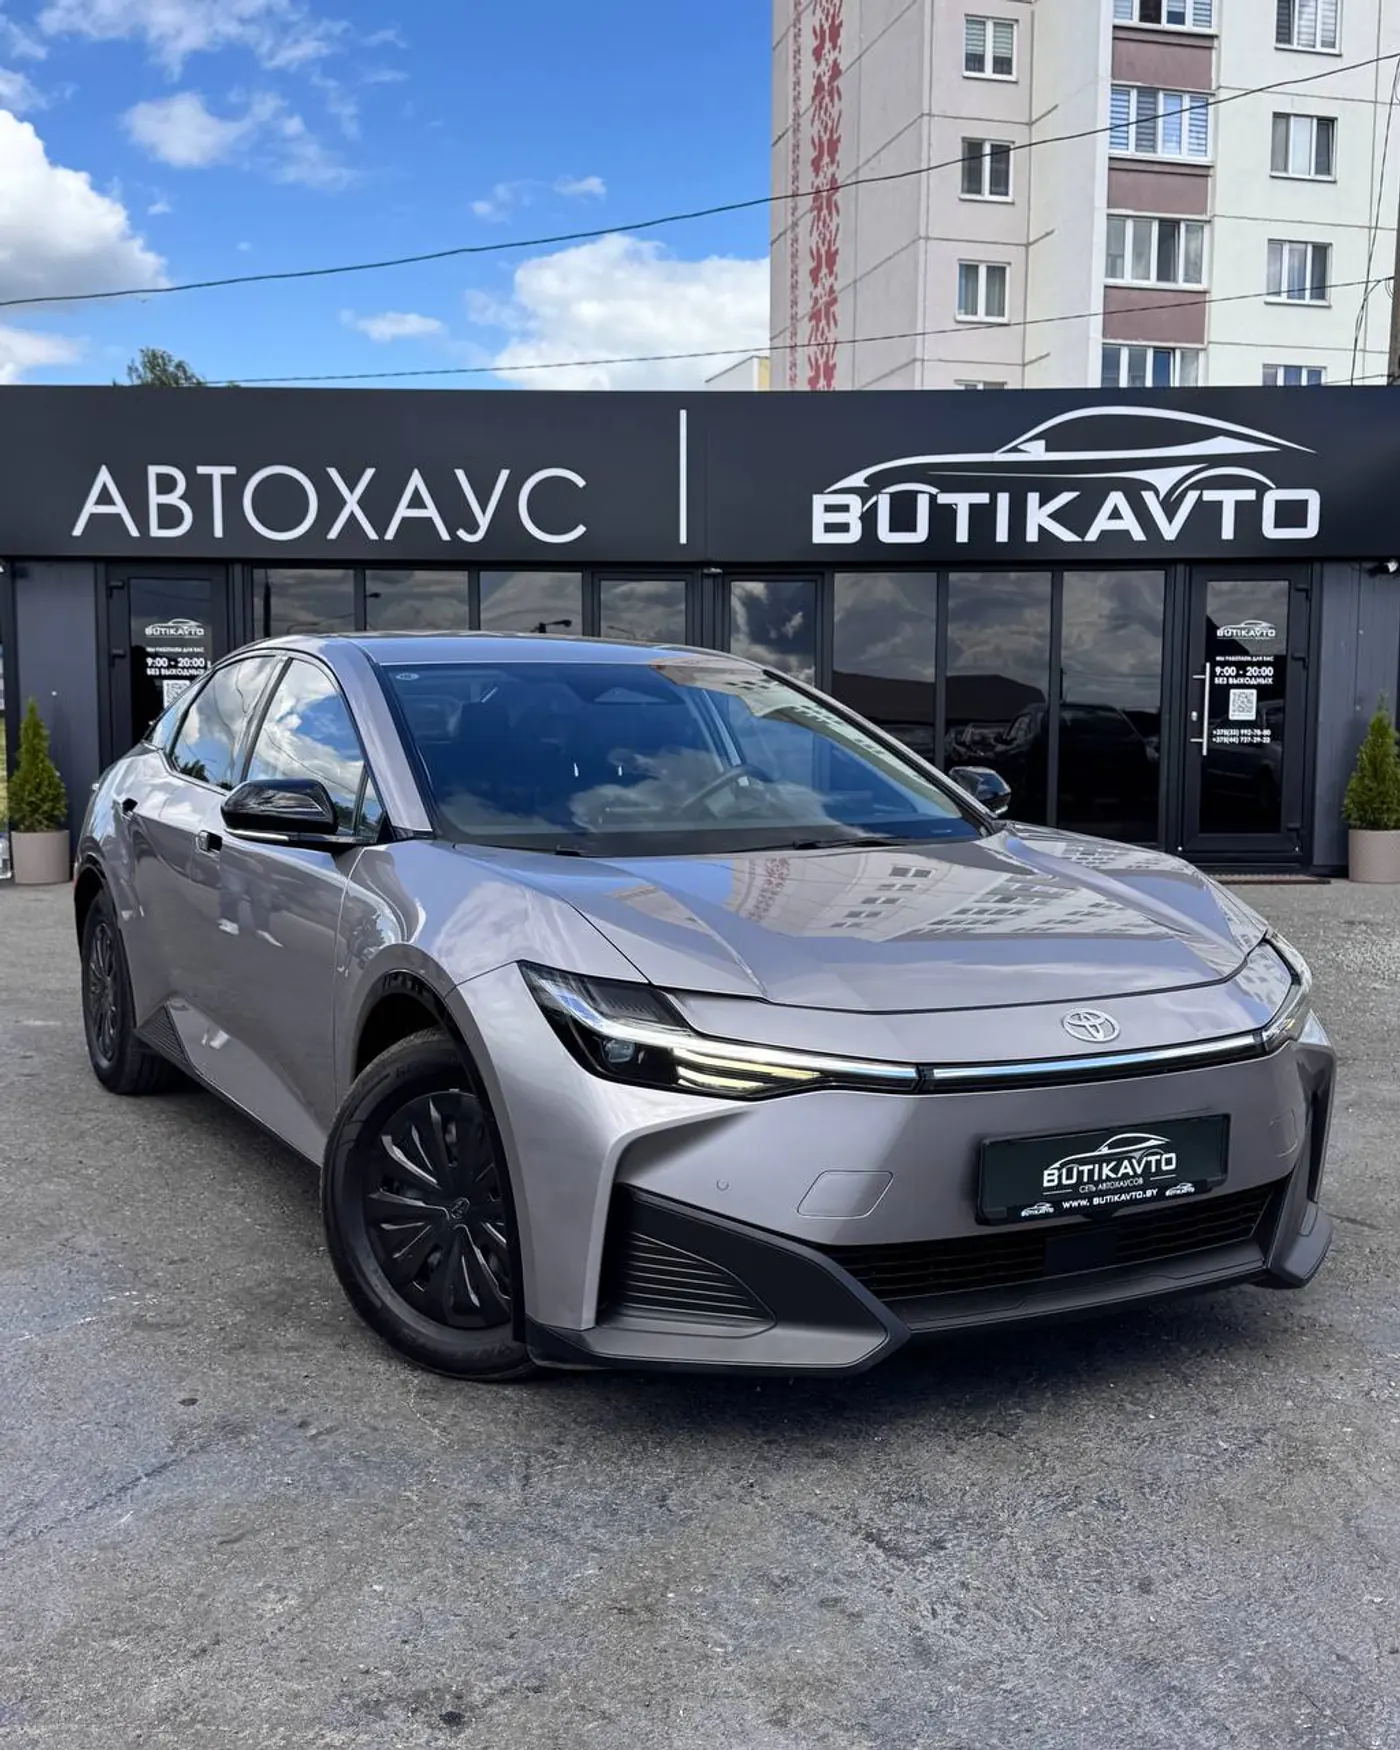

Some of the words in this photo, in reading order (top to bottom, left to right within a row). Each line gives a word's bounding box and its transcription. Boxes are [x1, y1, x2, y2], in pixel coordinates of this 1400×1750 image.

[72, 464, 587, 544] АВТОХАУС
[812, 487, 1321, 544] BUTIKAVTO
[145, 627, 204, 636] BUTIKAVTO
[1216, 628, 1276, 637] BUTIKAVTO
[146, 657, 168, 667] 9:00
[177, 657, 205, 667] 20:00
[146, 668, 159, 676] БЕЗ
[1215, 666, 1237, 676] 9:00
[1245, 666, 1274, 676] 20:00
[1214, 677, 1227, 685] БЕЗ
[1228, 677, 1273, 685] ВЫХОДНЫХ
[1043, 1153, 1176, 1188] BUTIKAVTO
[1062, 1199, 1090, 1210] WWW.
[1092, 1188, 1158, 1206] BUTIKAVTO.BY
